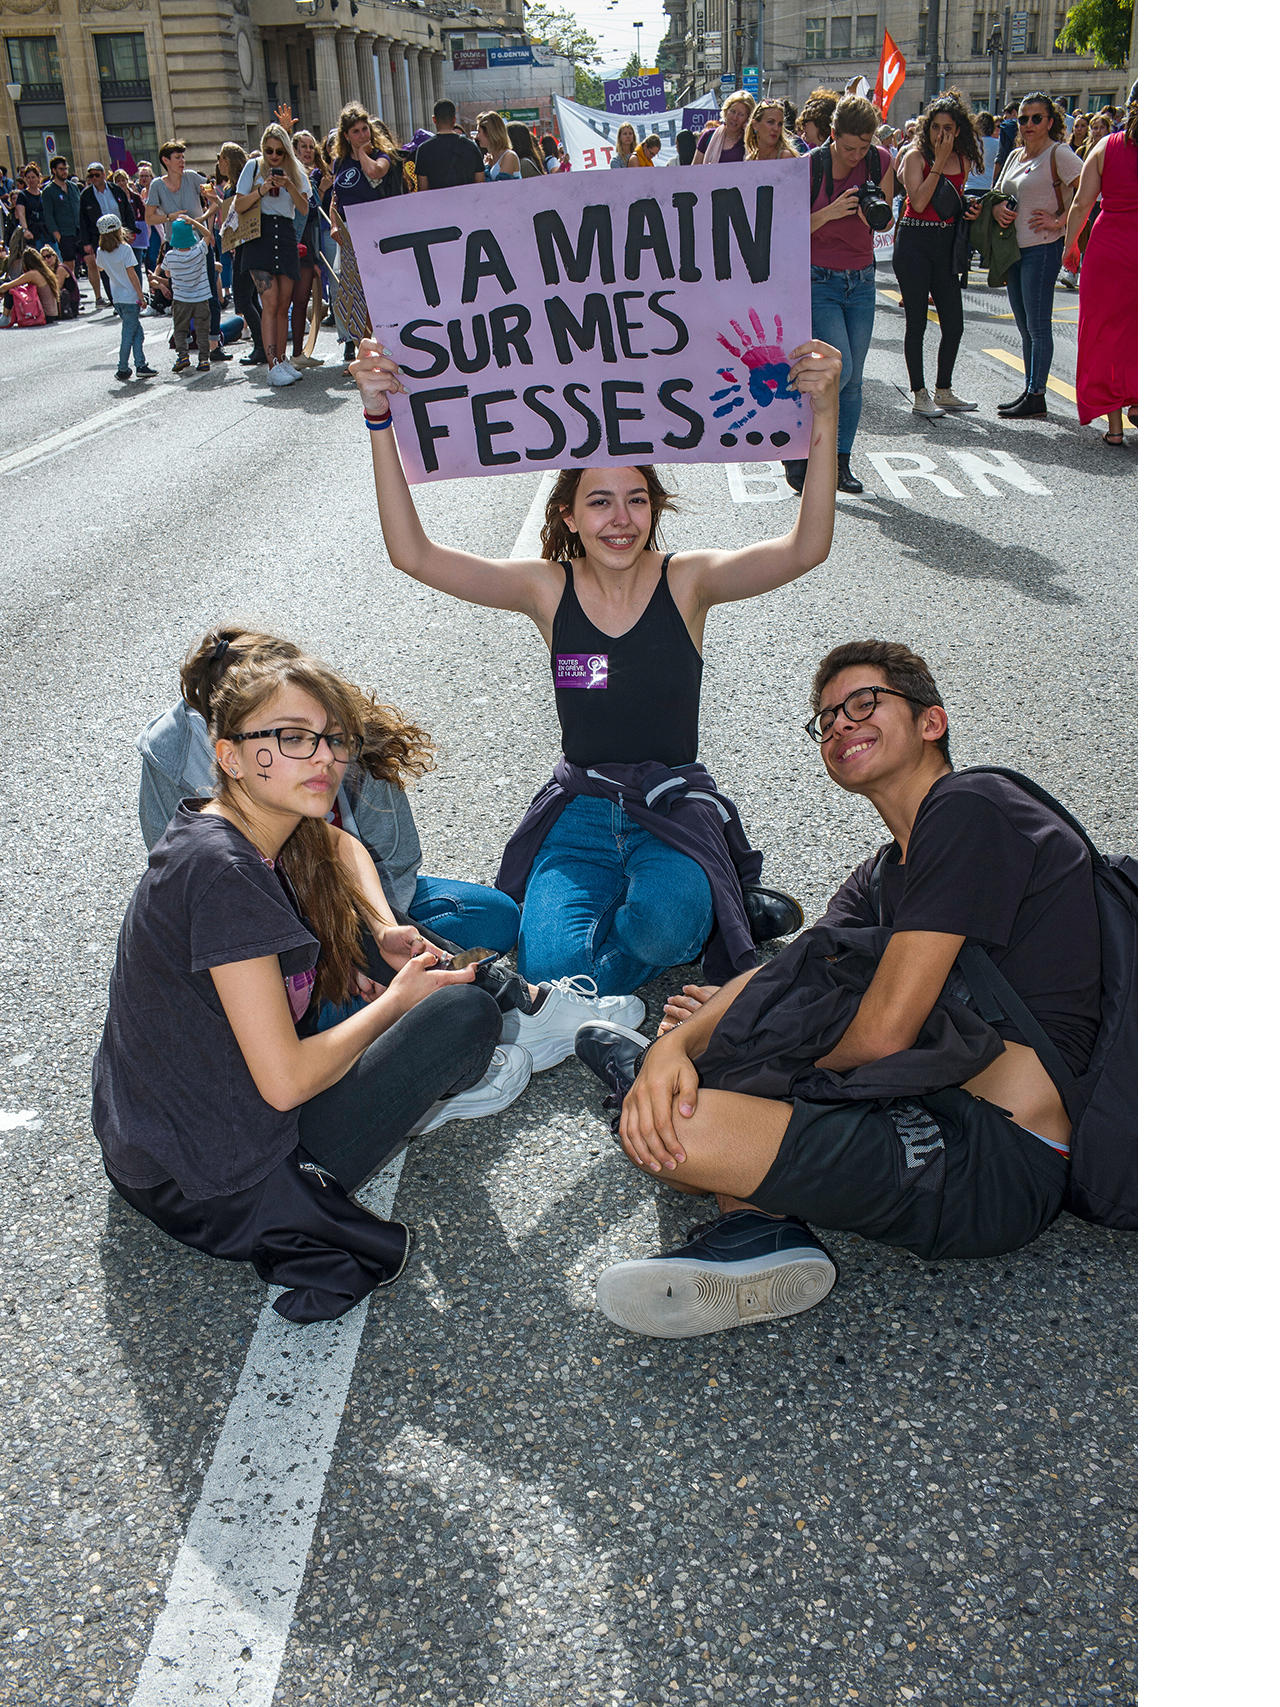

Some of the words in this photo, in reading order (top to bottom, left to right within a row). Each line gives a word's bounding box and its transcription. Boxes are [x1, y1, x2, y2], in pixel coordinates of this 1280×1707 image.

[621, 100, 650, 112] honte
[691, 115, 704, 124] en
[378, 226, 517, 308] TA
[532, 185, 774, 286] MAIN
[399, 303, 534, 379] SUR
[544, 290, 690, 365] MES
[725, 449, 1053, 504] BRN
